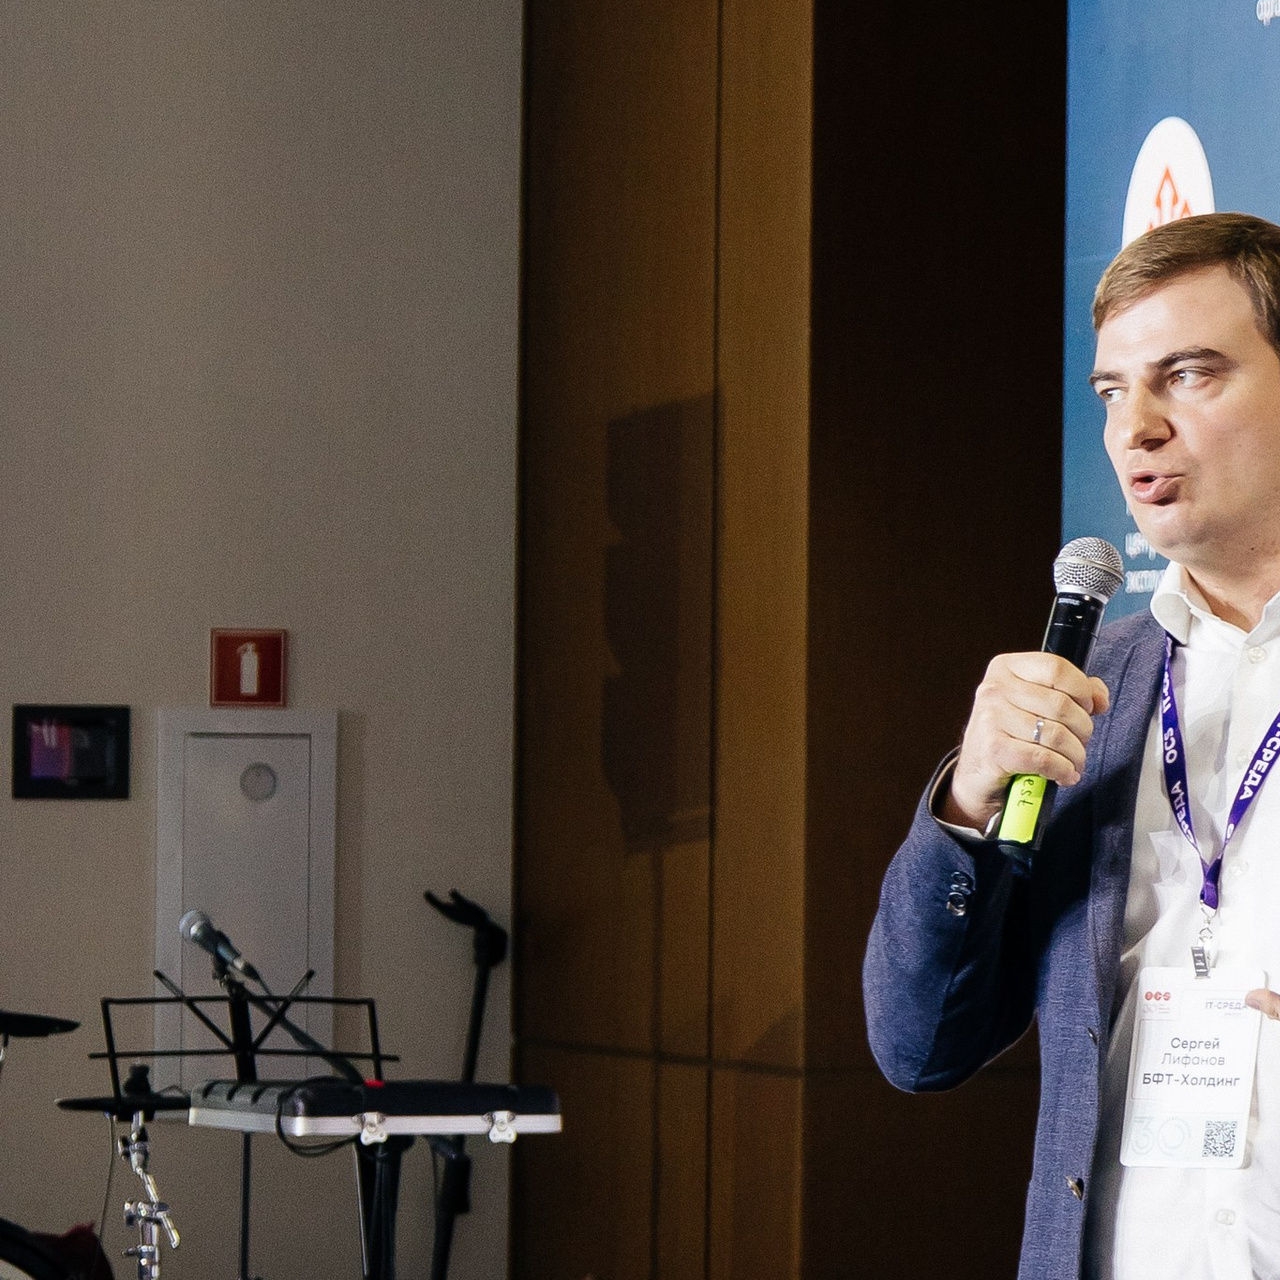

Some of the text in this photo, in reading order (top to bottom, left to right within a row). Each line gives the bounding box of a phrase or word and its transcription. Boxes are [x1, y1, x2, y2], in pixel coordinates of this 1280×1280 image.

[1164, 726, 1178, 764] OCS
[1170, 1037, 1220, 1052] Сергей
[1161, 1053, 1225, 1067] Лифанов
[1142, 1073, 1240, 1087] БФТ-Холдинг
